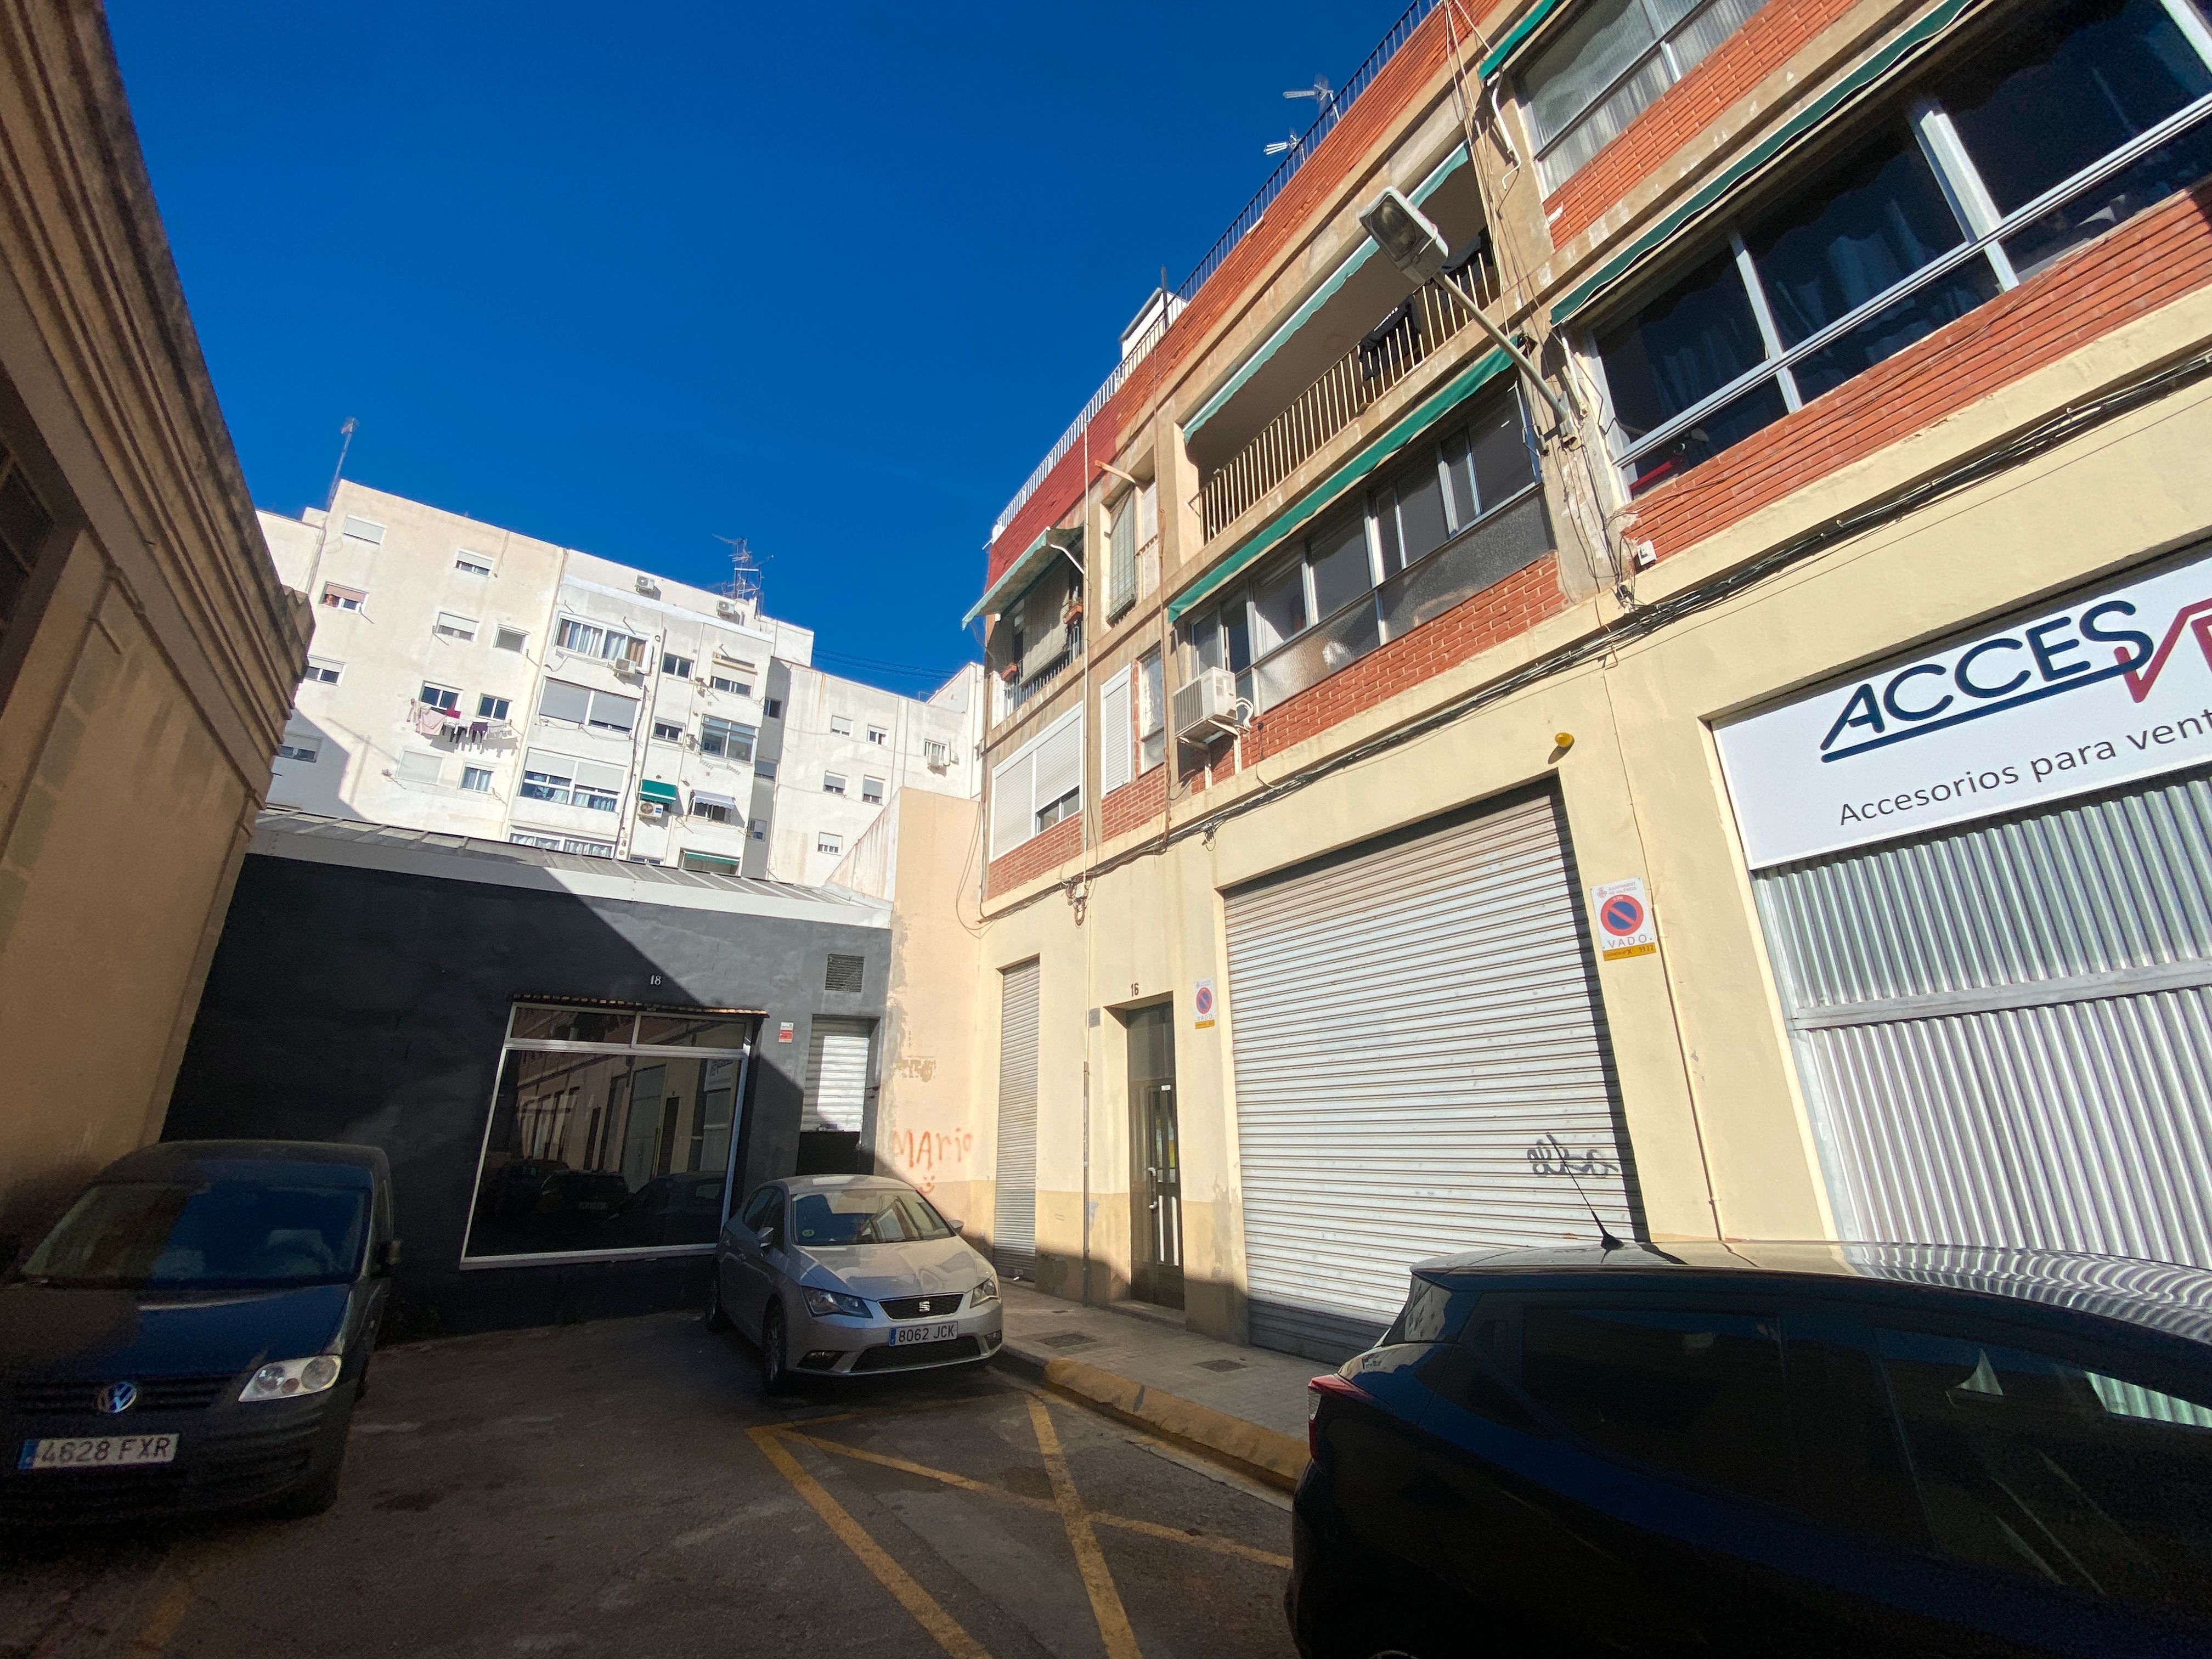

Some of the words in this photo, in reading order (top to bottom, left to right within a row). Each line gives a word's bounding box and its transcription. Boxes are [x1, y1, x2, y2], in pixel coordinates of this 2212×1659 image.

[1839, 766, 2019, 826] Accesorios
[2030, 741, 2116, 783] para
[1607, 934, 1647, 949] VADO
[650, 974, 662, 986] 18
[1131, 983, 1139, 997] 16
[898, 1328, 929, 1343] 8062
[933, 1324, 955, 1339] JCK
[41, 1440, 110, 1463] 4628
[118, 1436, 171, 1460] FXR
